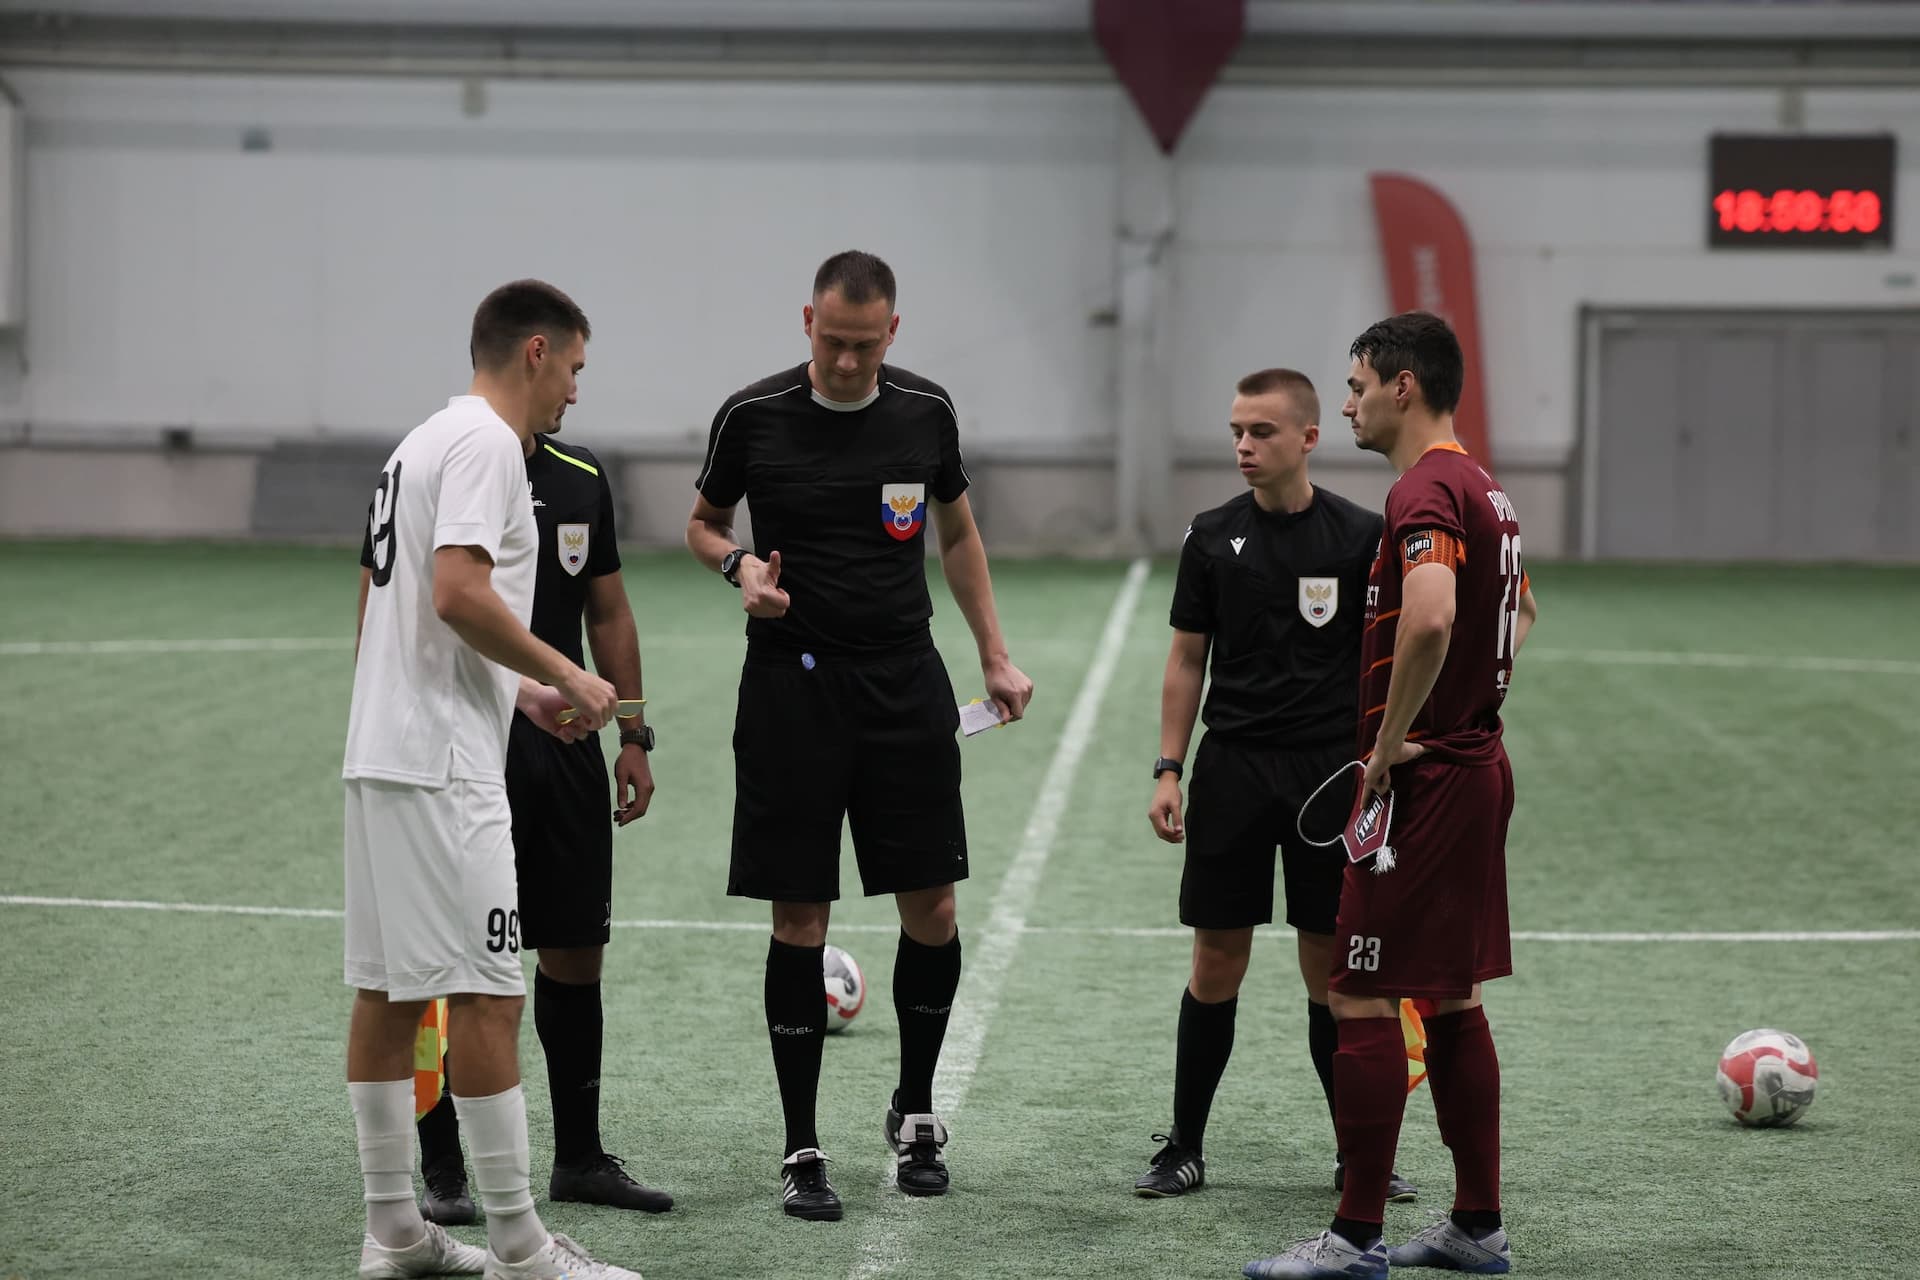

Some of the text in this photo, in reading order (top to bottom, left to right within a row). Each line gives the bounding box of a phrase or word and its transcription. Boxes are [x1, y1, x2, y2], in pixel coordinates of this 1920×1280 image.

[1406, 538, 1431, 558] ТЕМП
[1358, 799, 1382, 838] ТЕМП
[486, 907, 520, 954] 99
[1347, 934, 1382, 972] 23
